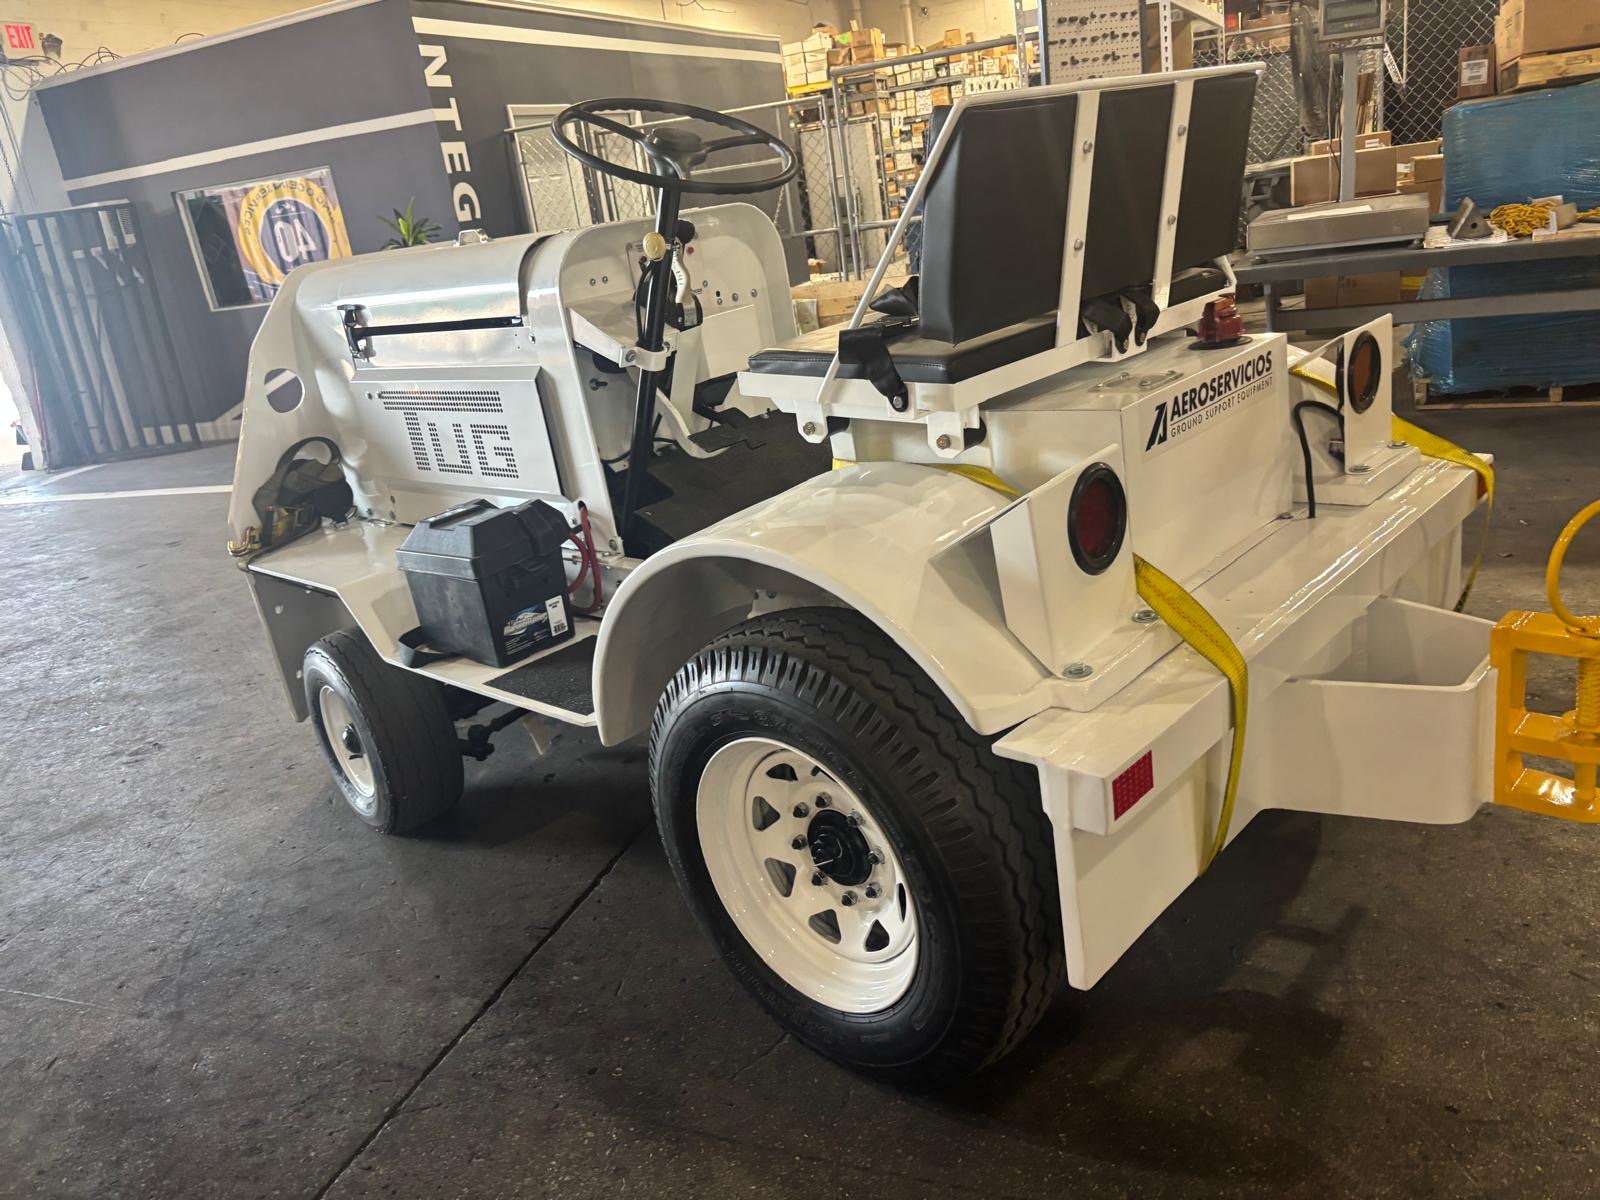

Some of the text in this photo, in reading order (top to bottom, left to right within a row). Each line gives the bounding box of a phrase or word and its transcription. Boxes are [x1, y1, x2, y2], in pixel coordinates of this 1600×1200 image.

[4, 24, 35, 48] EXIT
[1170, 350, 1273, 422] AEROSERVICIOS
[1170, 376, 1273, 438] GROUND SUPPORT EQUIPMENT
[380, 390, 519, 479] TUG
